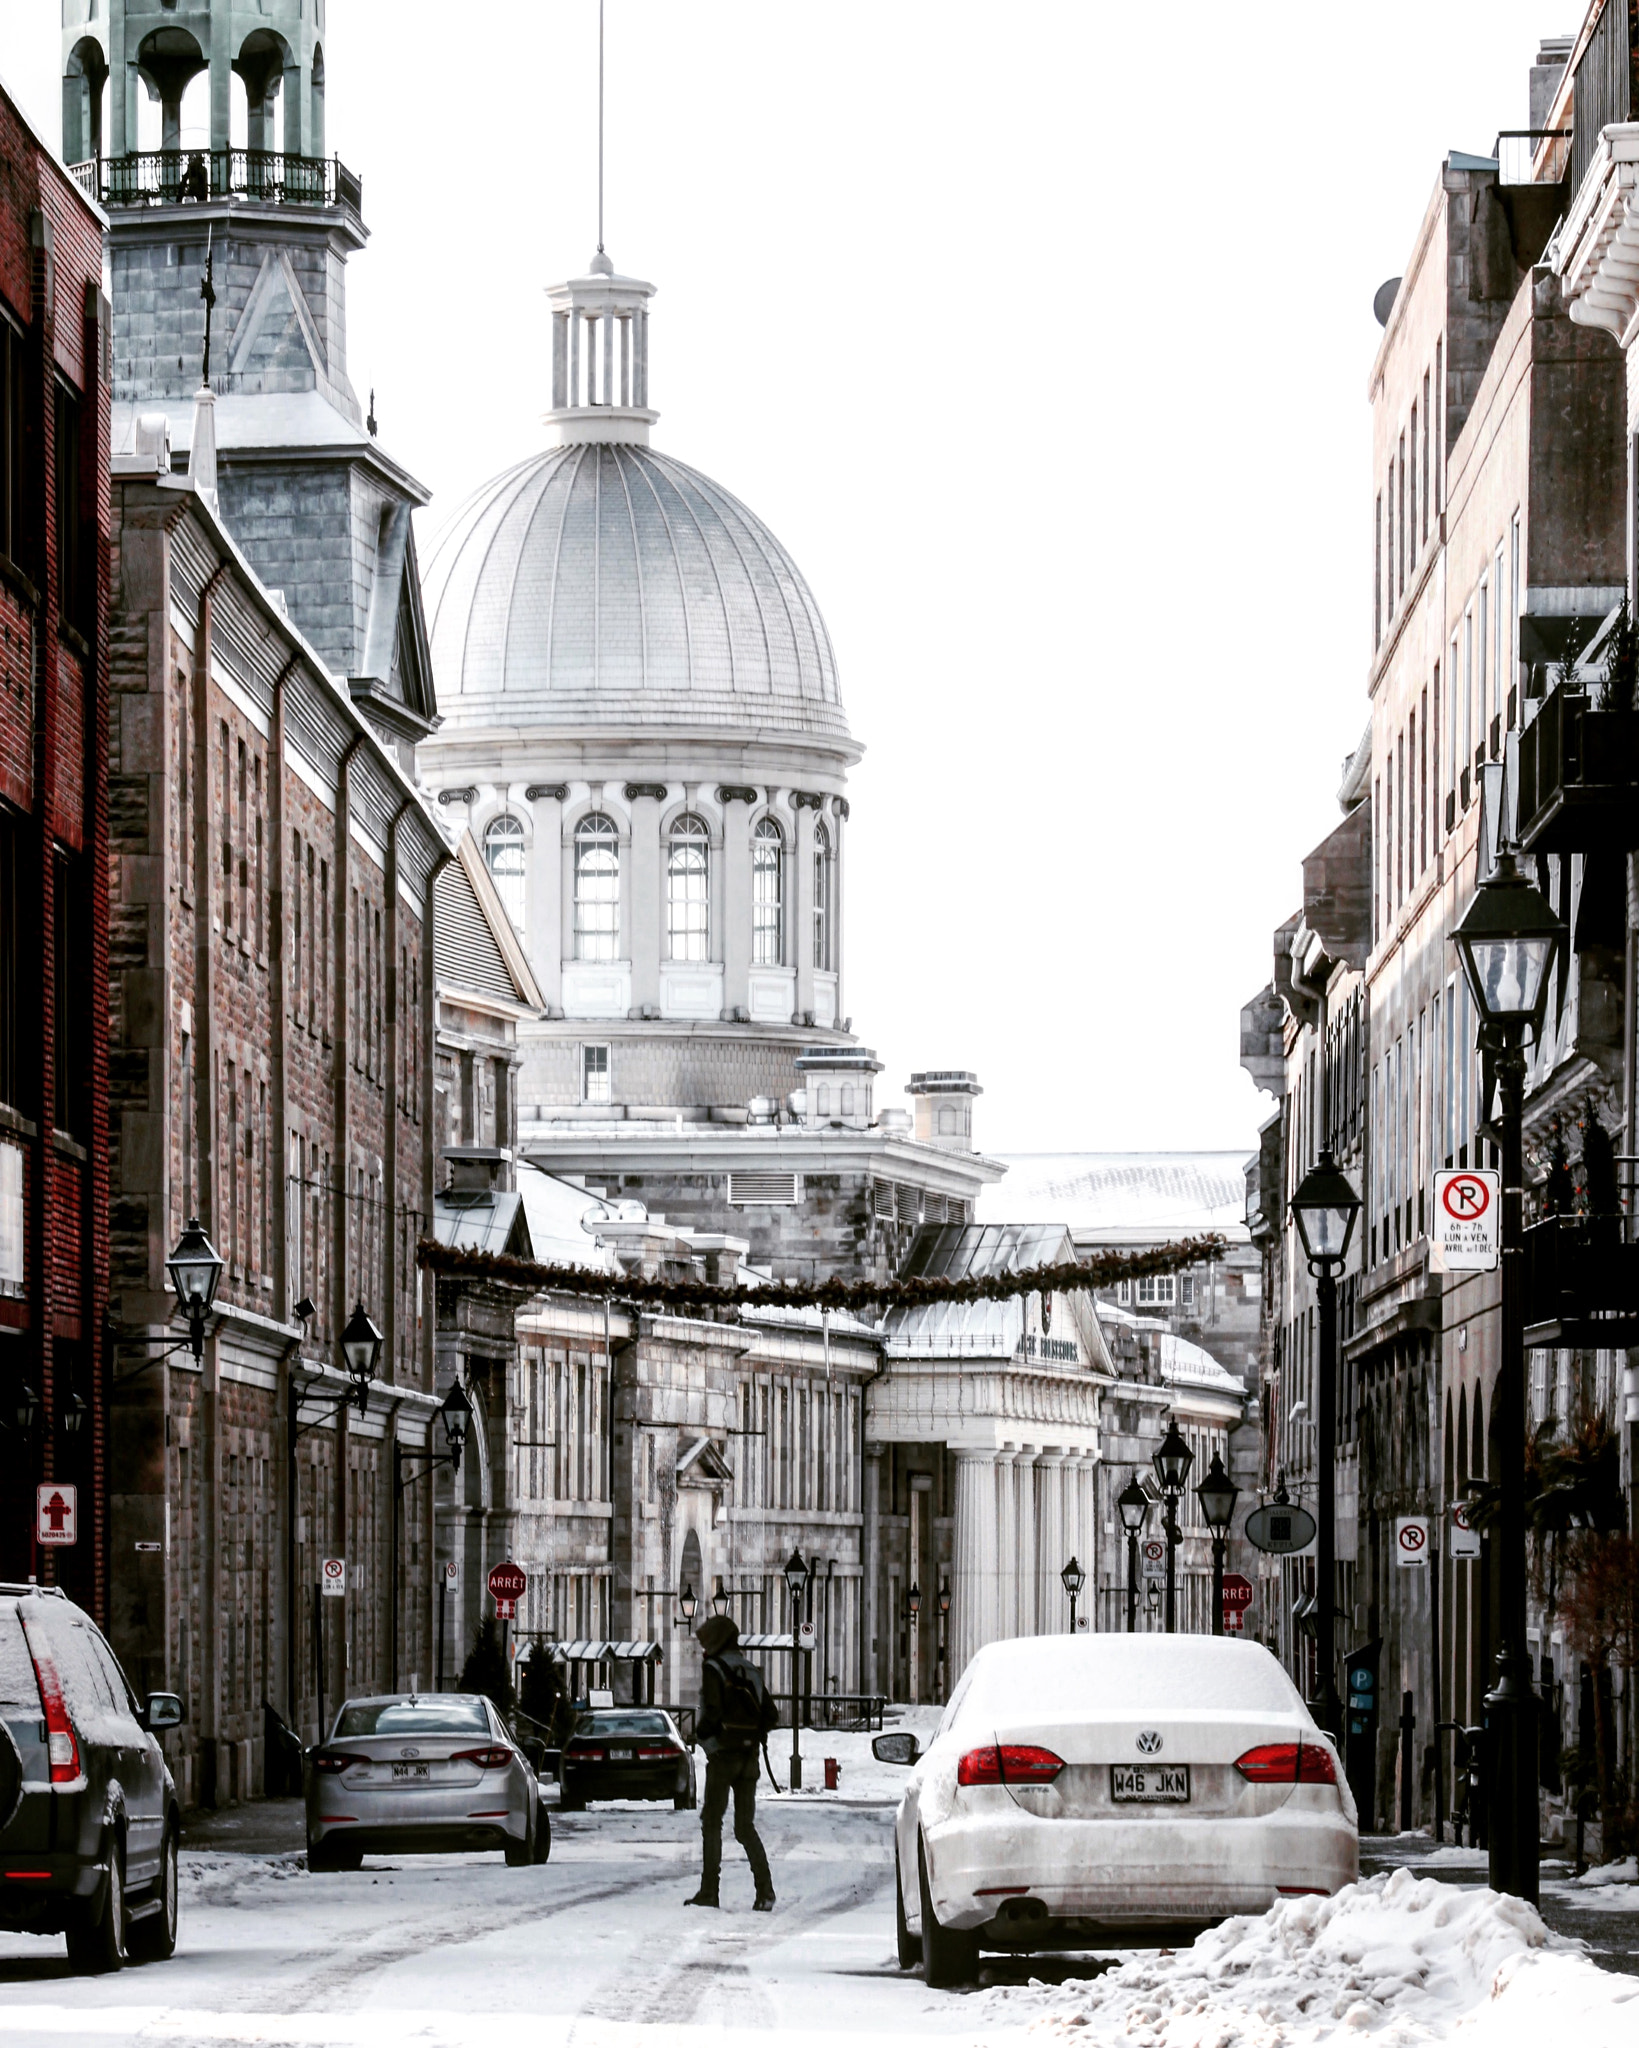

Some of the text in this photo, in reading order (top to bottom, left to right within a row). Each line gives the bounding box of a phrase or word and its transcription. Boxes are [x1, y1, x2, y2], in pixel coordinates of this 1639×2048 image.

[1450, 1222, 1461, 1231] 6h
[1472, 1222, 1483, 1231] 7h
[1444, 1233, 1461, 1242] LUN
[1470, 1233, 1488, 1242] VEN
[1445, 1244, 1463, 1253] AVRIL
[490, 1575, 525, 1590] ARRÊT
[1222, 1586, 1251, 1600] RRÊT
[1115, 1774, 1185, 1793] W46 JKN
